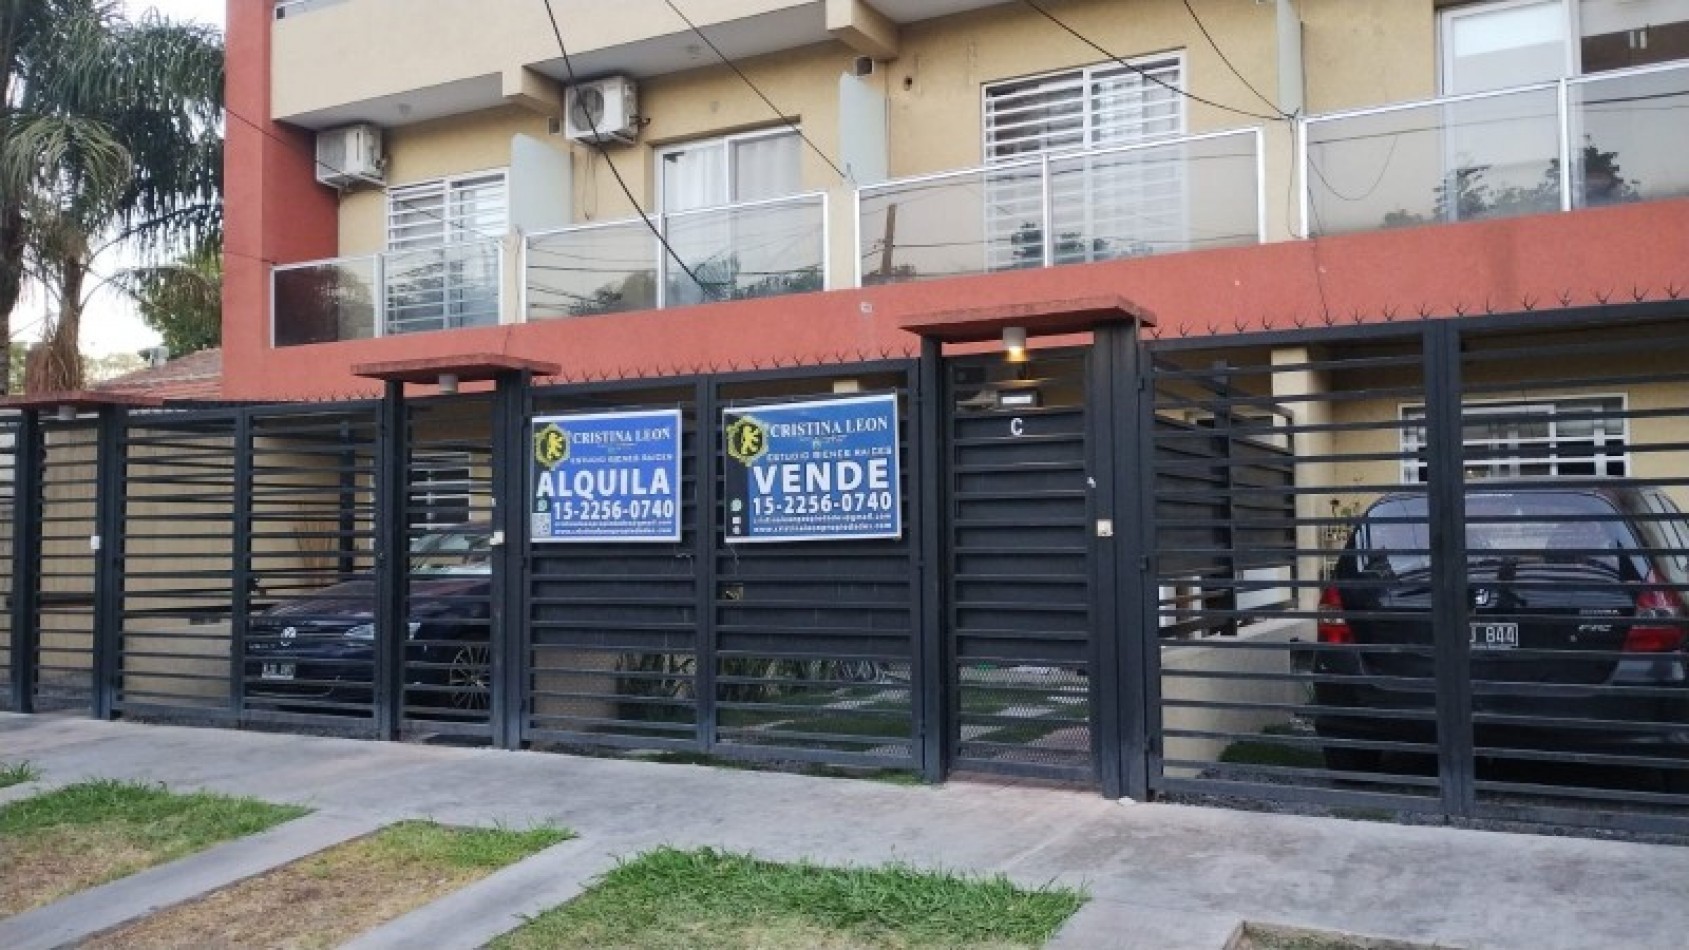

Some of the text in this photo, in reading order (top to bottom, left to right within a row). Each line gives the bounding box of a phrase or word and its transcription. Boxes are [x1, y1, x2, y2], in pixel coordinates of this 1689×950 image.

[572, 427, 671, 444] CRISTINA LEON
[770, 416, 888, 438] CRISTINA LEON
[1010, 417, 1023, 436] C
[536, 468, 671, 500] ALQUILA
[753, 458, 890, 494] VENDE
[554, 499, 674, 520] 15-2256-0740
[753, 492, 892, 516] 15-2256-0740
